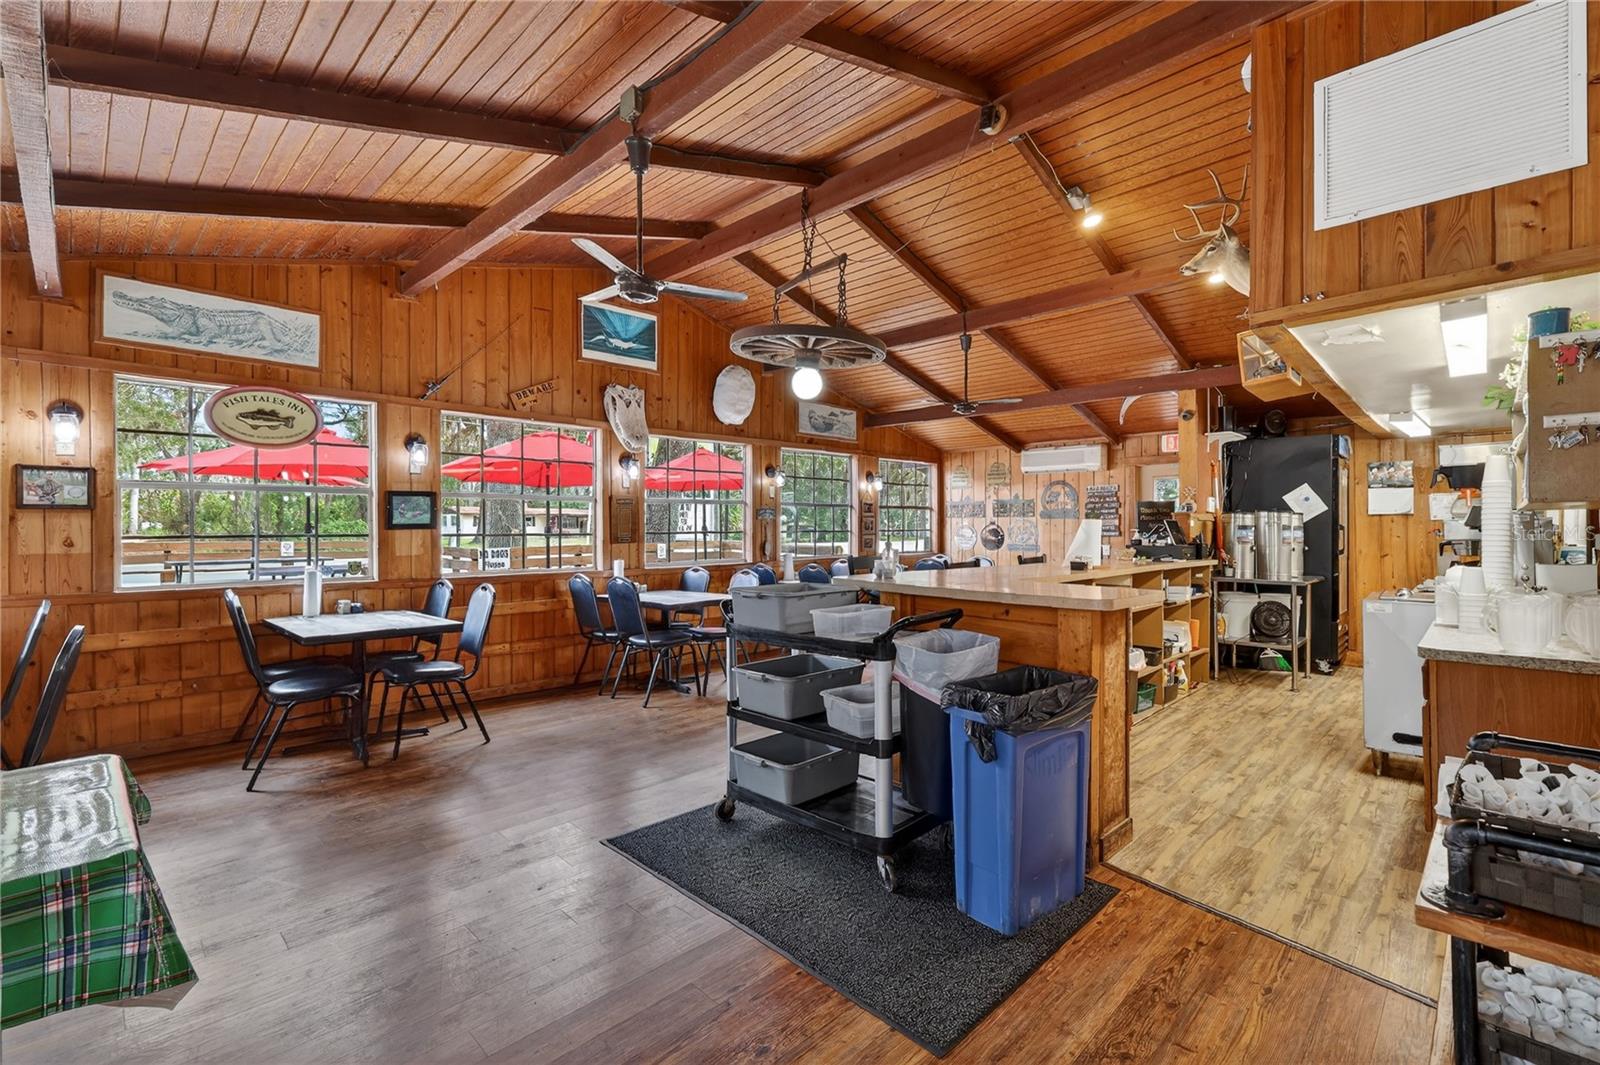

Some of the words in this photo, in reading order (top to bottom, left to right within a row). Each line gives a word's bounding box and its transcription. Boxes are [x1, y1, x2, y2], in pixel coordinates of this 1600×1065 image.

[516, 382, 553, 401] BEWARE
[223, 395, 248, 408] FISH
[250, 395, 285, 406] TALES
[287, 402, 306, 415] INN
